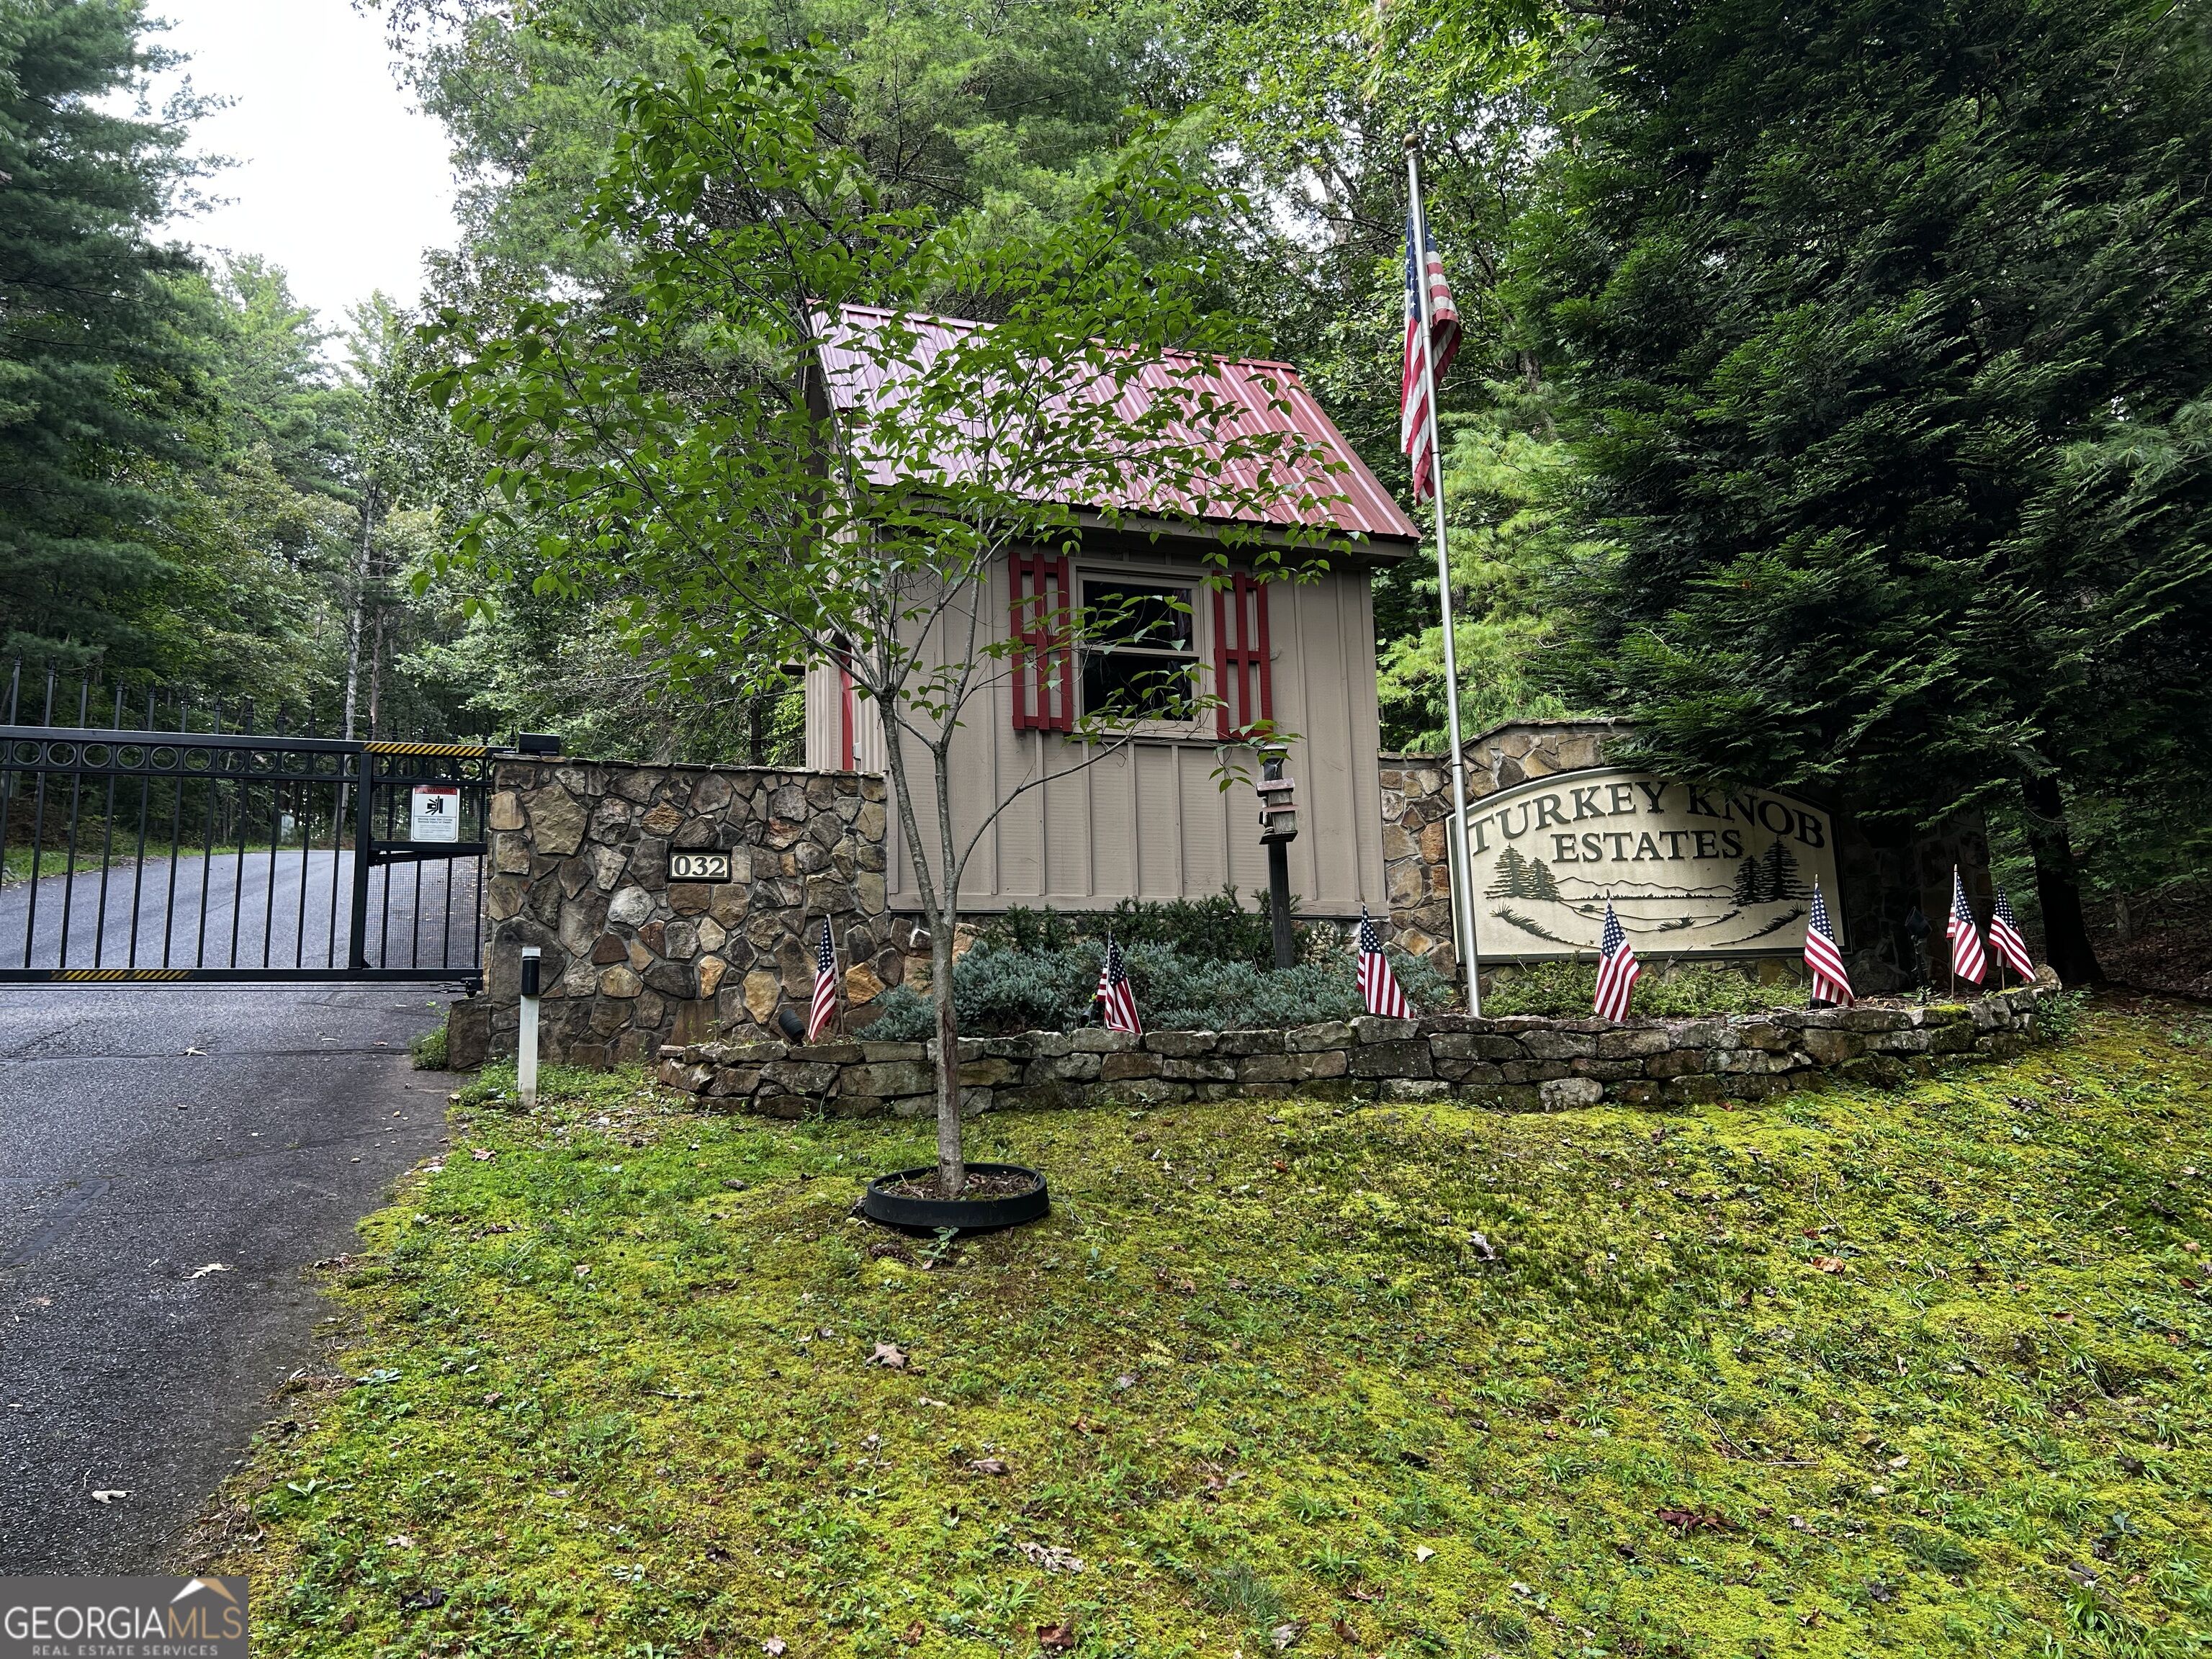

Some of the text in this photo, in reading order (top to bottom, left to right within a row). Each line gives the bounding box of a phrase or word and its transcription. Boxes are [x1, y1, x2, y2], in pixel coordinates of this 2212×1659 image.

[1467, 781, 1825, 857] TURKEY KNOB
[1550, 830, 1744, 863] ESTATES
[674, 855, 725, 876] 032
